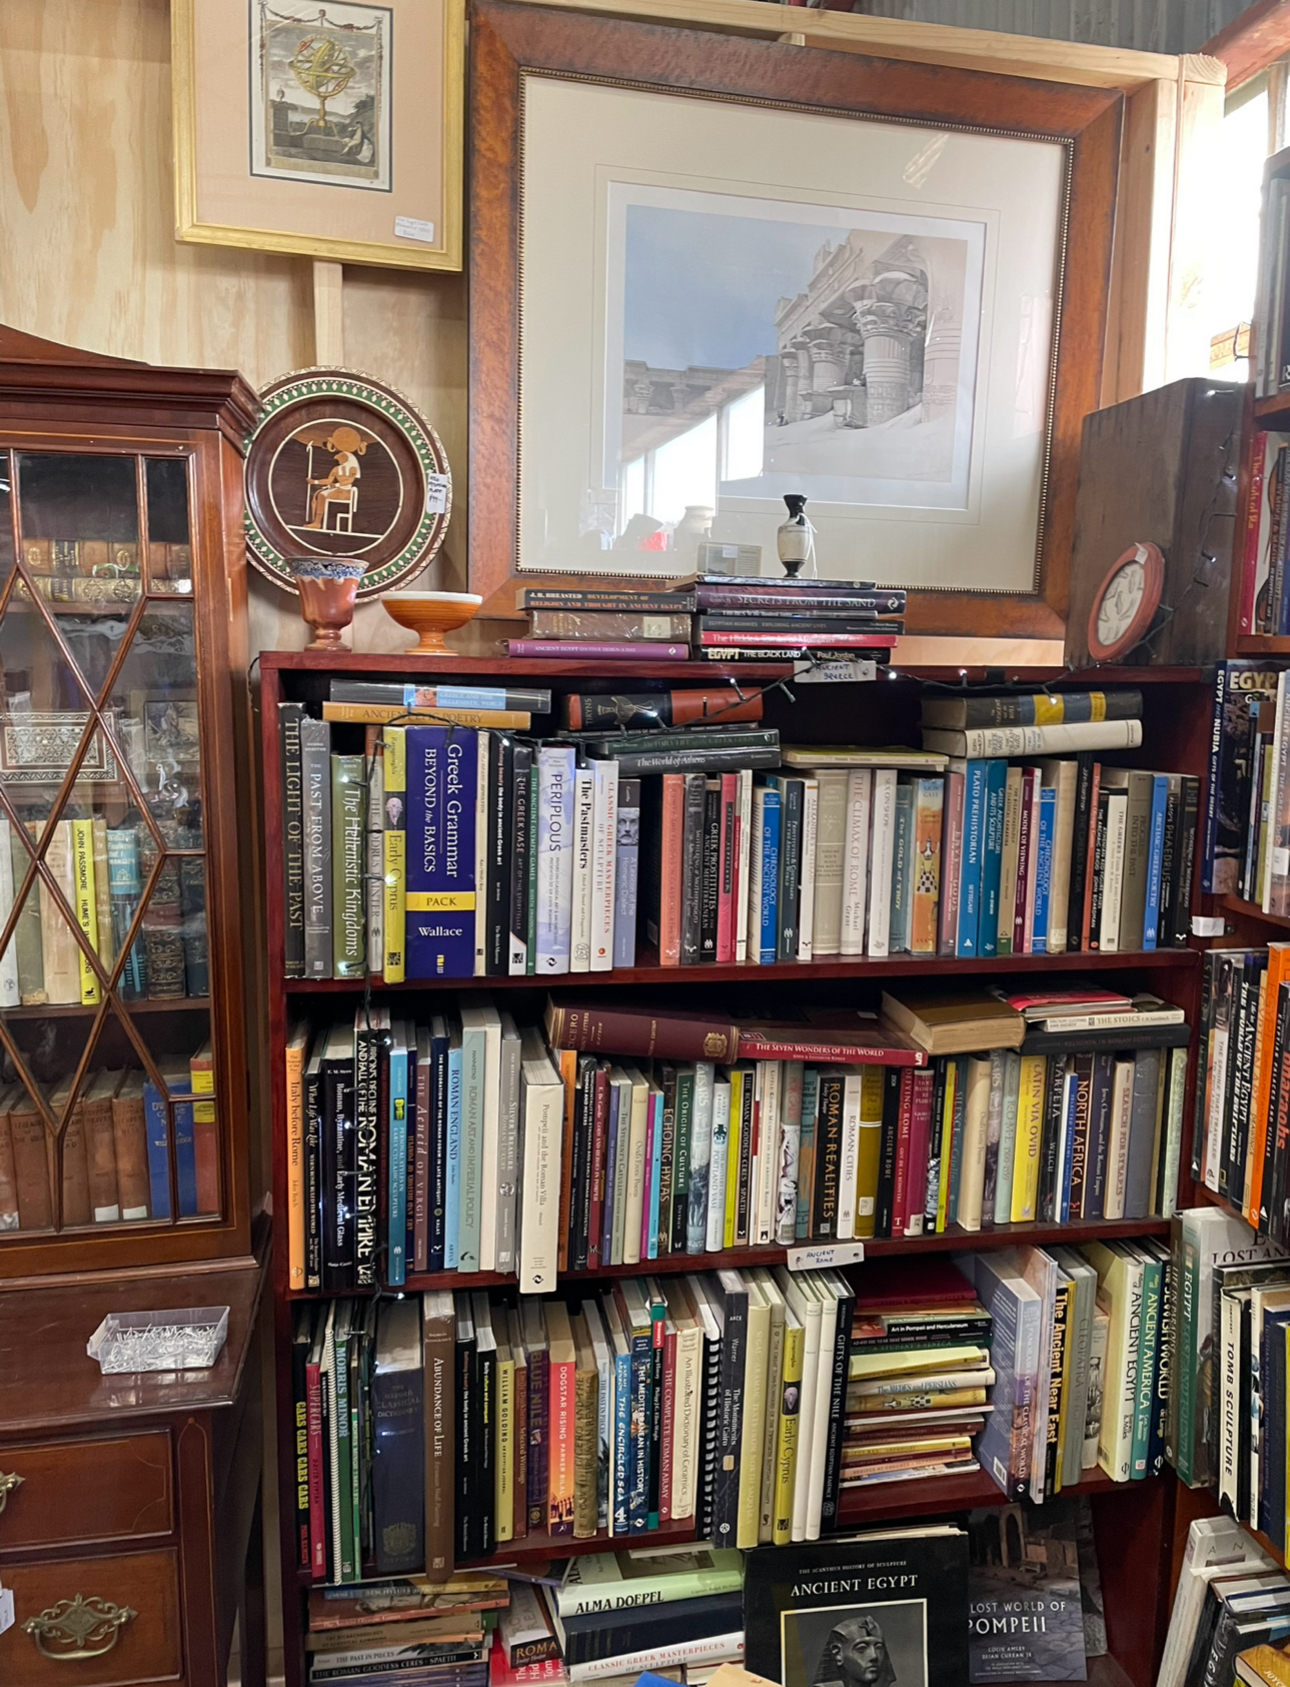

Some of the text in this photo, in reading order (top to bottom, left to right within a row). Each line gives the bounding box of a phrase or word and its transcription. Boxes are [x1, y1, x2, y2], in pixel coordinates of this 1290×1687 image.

[736, 595, 876, 608] SECRETS FROM THE SAND
[708, 649, 740, 660] EGYPT
[785, 651, 802, 659] LAND
[817, 651, 835, 659] Paul
[837, 651, 855, 660] Jordan
[444, 712, 483, 723] POETRY
[1212, 670, 1225, 753] EGYPT NUBIA
[285, 718, 303, 930] THE LIGHT OF THE PAST
[310, 773, 323, 914] PAST FROM ABOVE
[423, 748, 436, 873] BEYOND the BASICS
[446, 744, 462, 878] Greek Grammar
[516, 777, 526, 853] THE GREEK VASE
[548, 774, 563, 852] PERIPLOUS
[579, 779, 592, 869] The Pastmasters
[763, 827, 770, 839] OF
[763, 841, 771, 854] THE
[848, 774, 863, 897] THE CLIMAX OF ROME
[968, 770, 981, 864] PLATO PREHISTORIAN
[77, 828, 90, 927] JOHN PASSMORE HUME'S
[342, 788, 361, 956] The Hellenistic Kingdoms
[387, 834, 402, 911] Early Cyprus
[596, 823, 605, 893] OF SCULPTURE
[604, 782, 615, 934] CLASSIC GREEK MASTERPIECES
[709, 823, 718, 910] GREEK PROSTITUTES
[769, 847, 777, 905] CHRONOLOGY
[418, 927, 463, 937] Wallace
[426, 897, 457, 908] PACK
[756, 1043, 884, 1057] THE SEVEN WONDERS OF THE WORLD
[1238, 1024, 1256, 1124] ANCIENT EGYPT
[288, 1081, 301, 1166] Italy before Rome
[449, 1069, 460, 1160] ROMAN ENGLAND
[539, 1104, 550, 1133] Pompeii
[678, 1082, 690, 1188] THE ORIGIN OF CULTURE
[847, 1115, 856, 1153] ROMAN
[1029, 1064, 1043, 1158] LATIN VIA OVID
[1071, 1080, 1089, 1186] NORTH AFRICA
[1277, 1051, 1290, 1149] pharaohs
[357, 1116, 376, 1258] ROMAN EMPIRE
[660, 1108, 673, 1202] ECHOING HYLAS
[823, 1083, 840, 1218] ROMAN REALITIES
[539, 1190, 547, 1206] Villa
[1183, 1271, 1193, 1321] EGYPT
[559, 1366, 567, 1408] DOGSTAR
[831, 1334, 845, 1419] GIFTS OF THE NILE
[1046, 1293, 1068, 1444] The Ancient Near East
[1124, 1292, 1141, 1403] ANCIENT EGYPT
[1139, 1292, 1158, 1409] ANCIENT AMERICA
[310, 1384, 321, 1436] SUPERCARS
[336, 1347, 348, 1438] MORRIS MINOR
[433, 1358, 444, 1457] ABUNDANCE OF LIFE
[559, 1411, 567, 1440] RISING
[661, 1369, 673, 1499] THE COMPLETE ROMAN ARMY
[680, 1357, 692, 1495] An Illustrated Dictionary of Ceramics
[1224, 1341, 1235, 1477] TOMB SCULPTURE
[296, 1402, 308, 1509] CARS CARS CARS CARS
[781, 1418, 796, 1484] Early Cyprus
[575, 1591, 664, 1614] ALMA DOEPEL
[791, 1574, 919, 1597] ANCIENT EGYPT
[971, 1602, 1066, 1614] LOST WORLD OF
